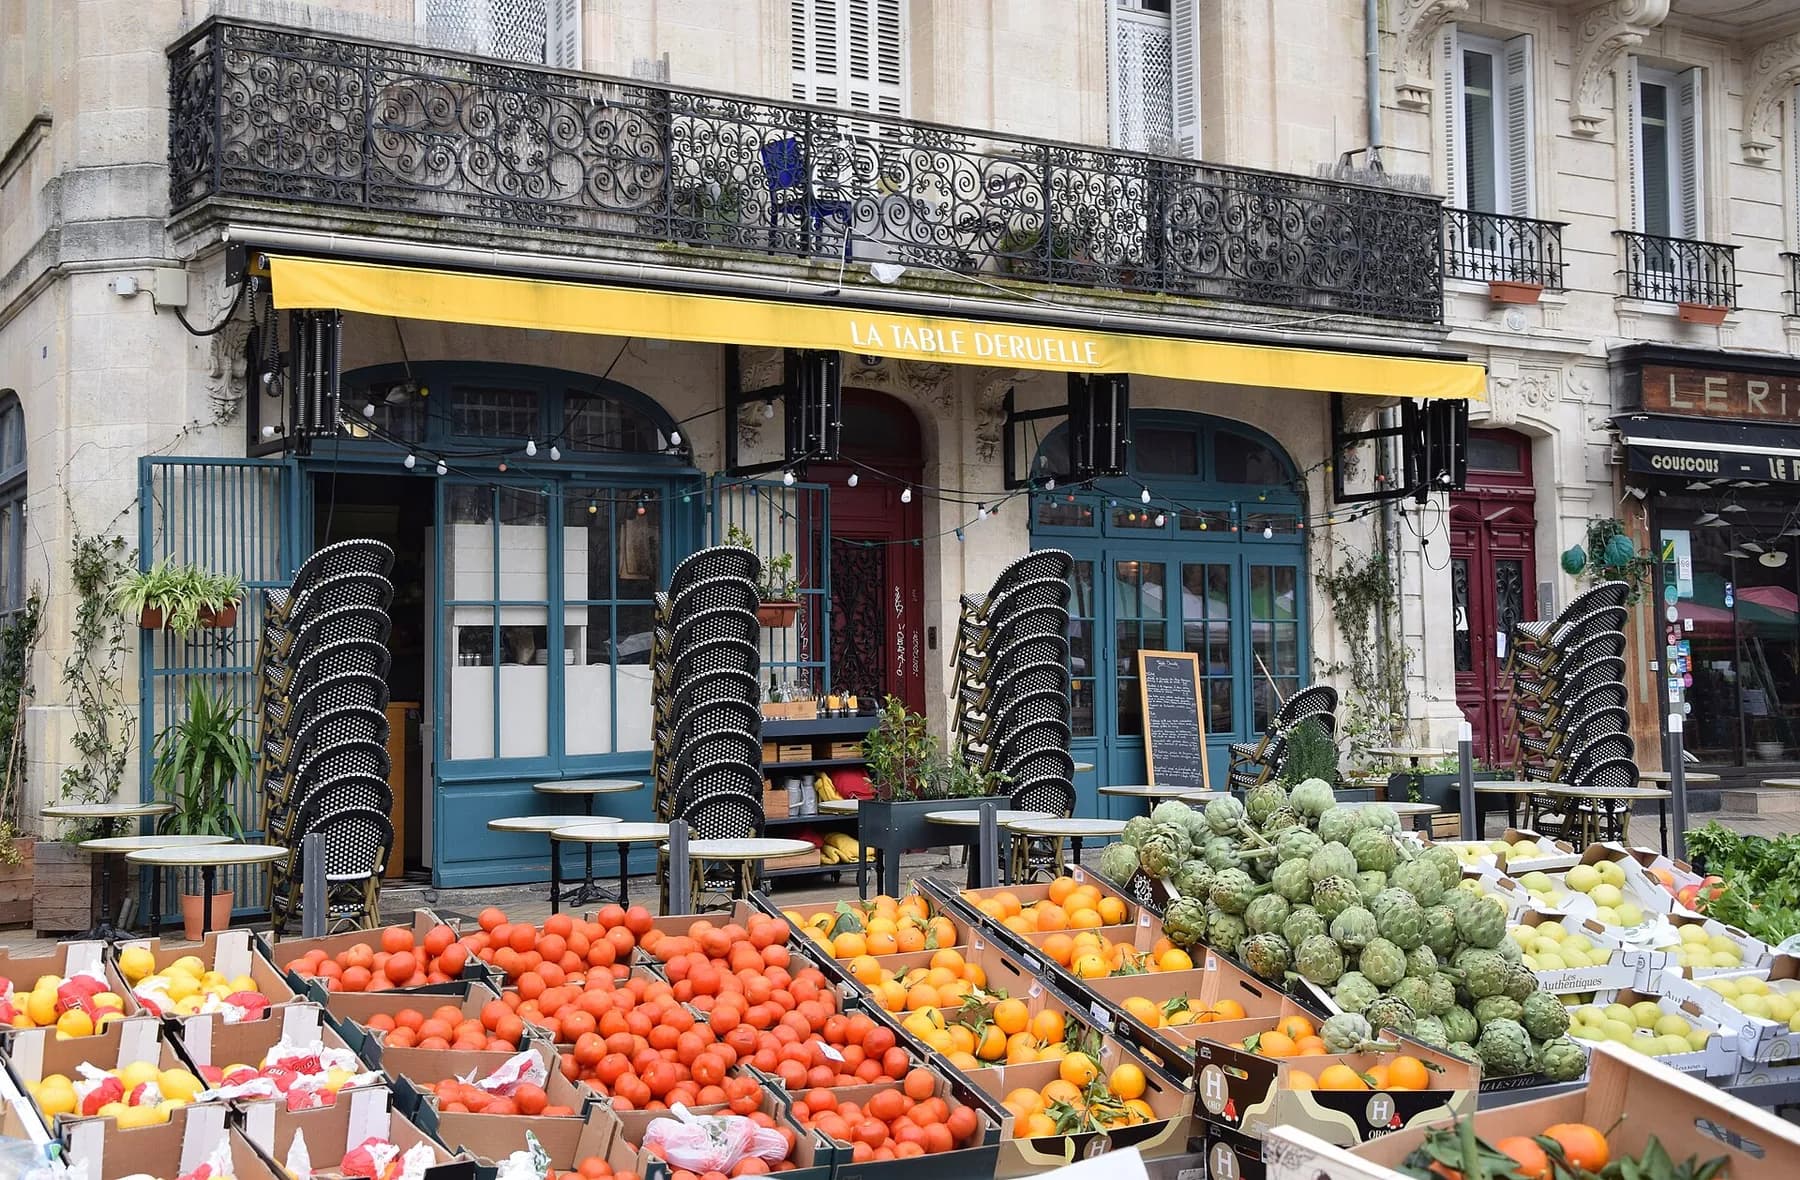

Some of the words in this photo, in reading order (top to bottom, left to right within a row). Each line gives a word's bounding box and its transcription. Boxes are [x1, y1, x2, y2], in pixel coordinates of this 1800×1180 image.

[850, 321, 883, 347] LA
[890, 325, 966, 354] TABLE
[974, 332, 1099, 365] DERUELLE
[1669, 373, 1729, 412] LE
[1651, 454, 1720, 473] COUSCOUS
[1542, 977, 1602, 990] Authentiques
[1206, 1070, 1222, 1100] H
[1372, 1101, 1389, 1120] H
[1216, 1148, 1234, 1179] H
